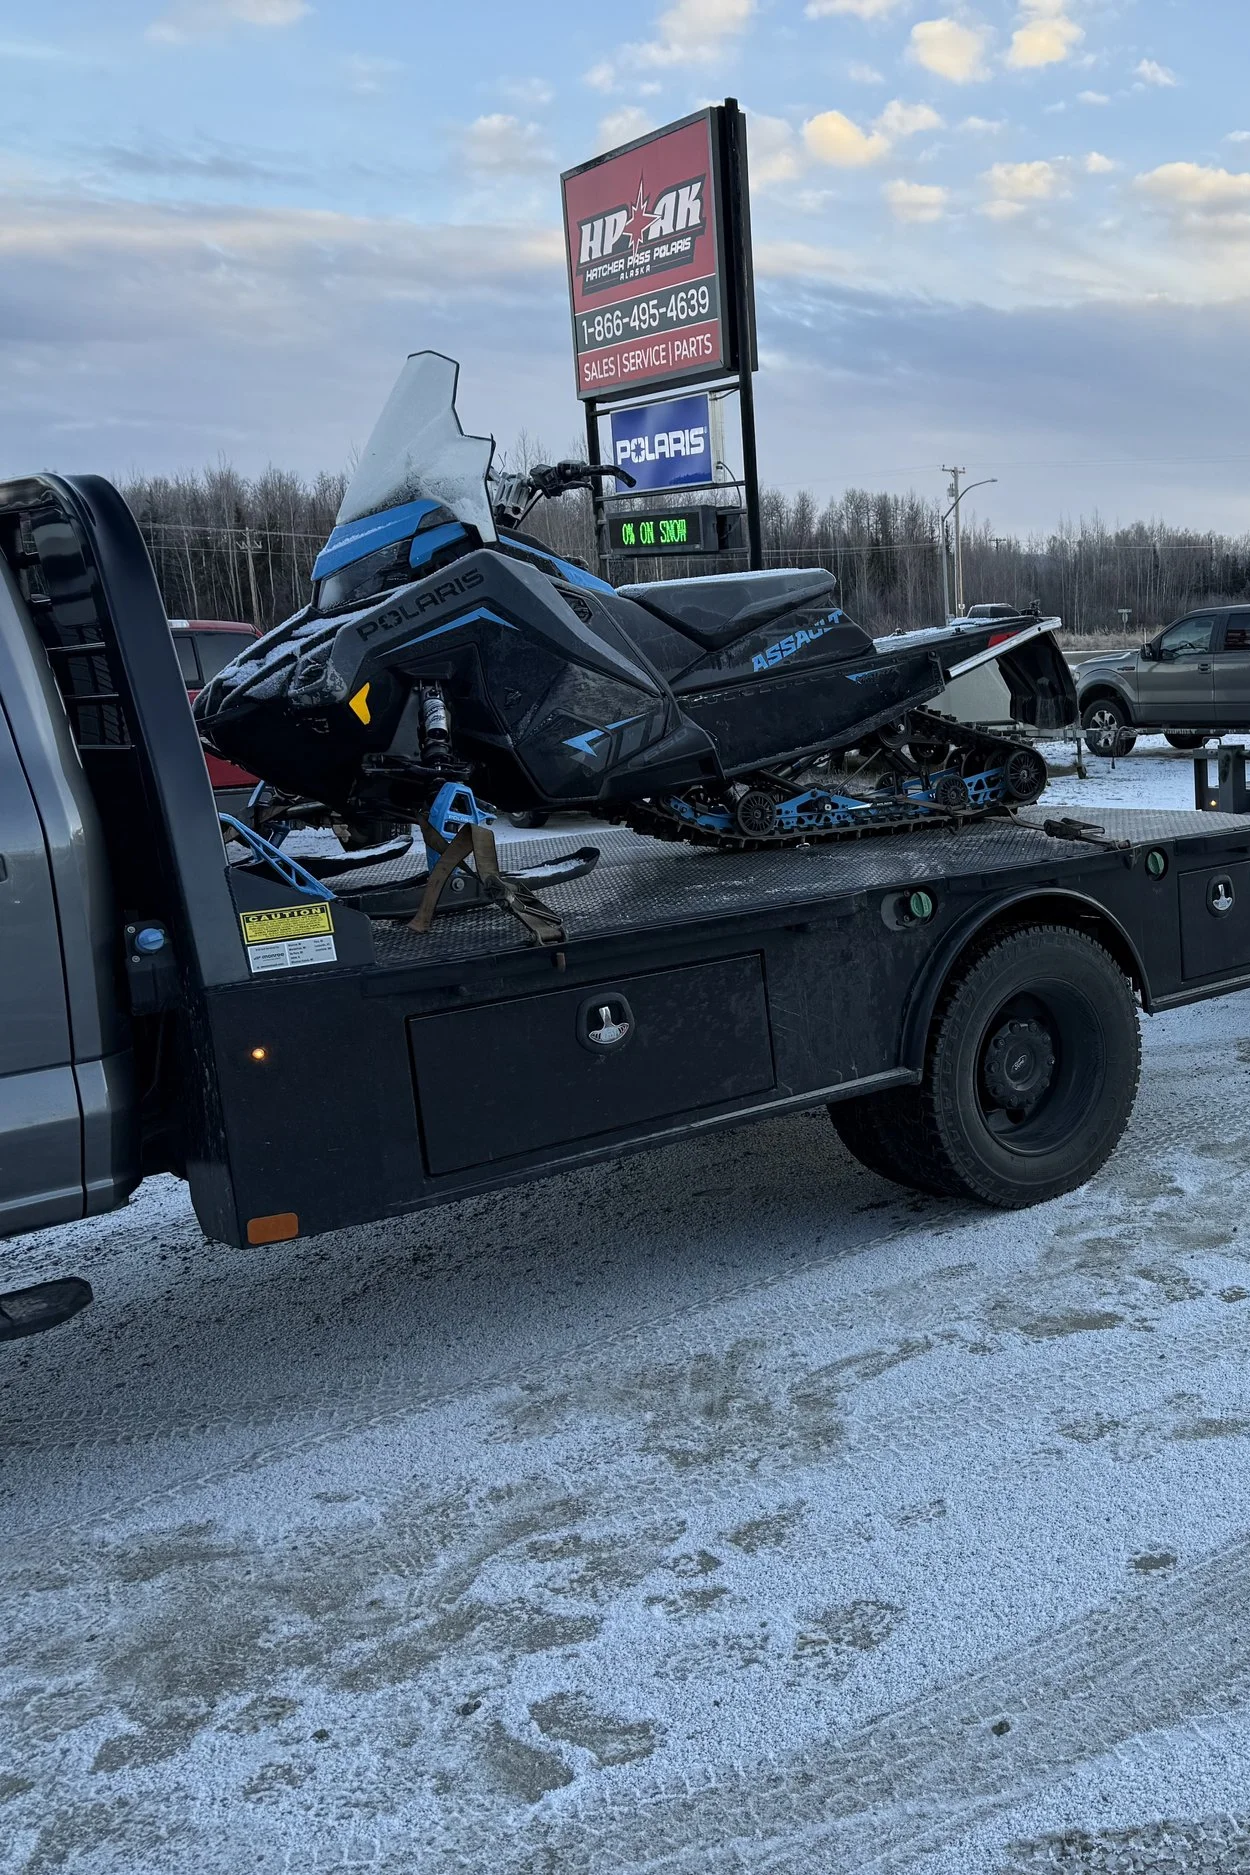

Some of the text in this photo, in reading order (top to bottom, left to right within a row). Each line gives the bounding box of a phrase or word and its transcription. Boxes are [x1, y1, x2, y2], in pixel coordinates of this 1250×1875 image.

[580, 181, 701, 264] HP AK
[586, 237, 692, 282] HATCHER PASS POLARIS
[619, 264, 651, 281] ALASKA
[581, 286, 709, 345] 1-866-495-4639
[584, 333, 713, 382] SALES SERVICE PARTS
[616, 427, 704, 466] POLARIS
[640, 521, 655, 544] ON
[356, 567, 485, 642] POLARIS
[752, 608, 843, 673] ASSAULT
[248, 907, 322, 922] CAUTION
